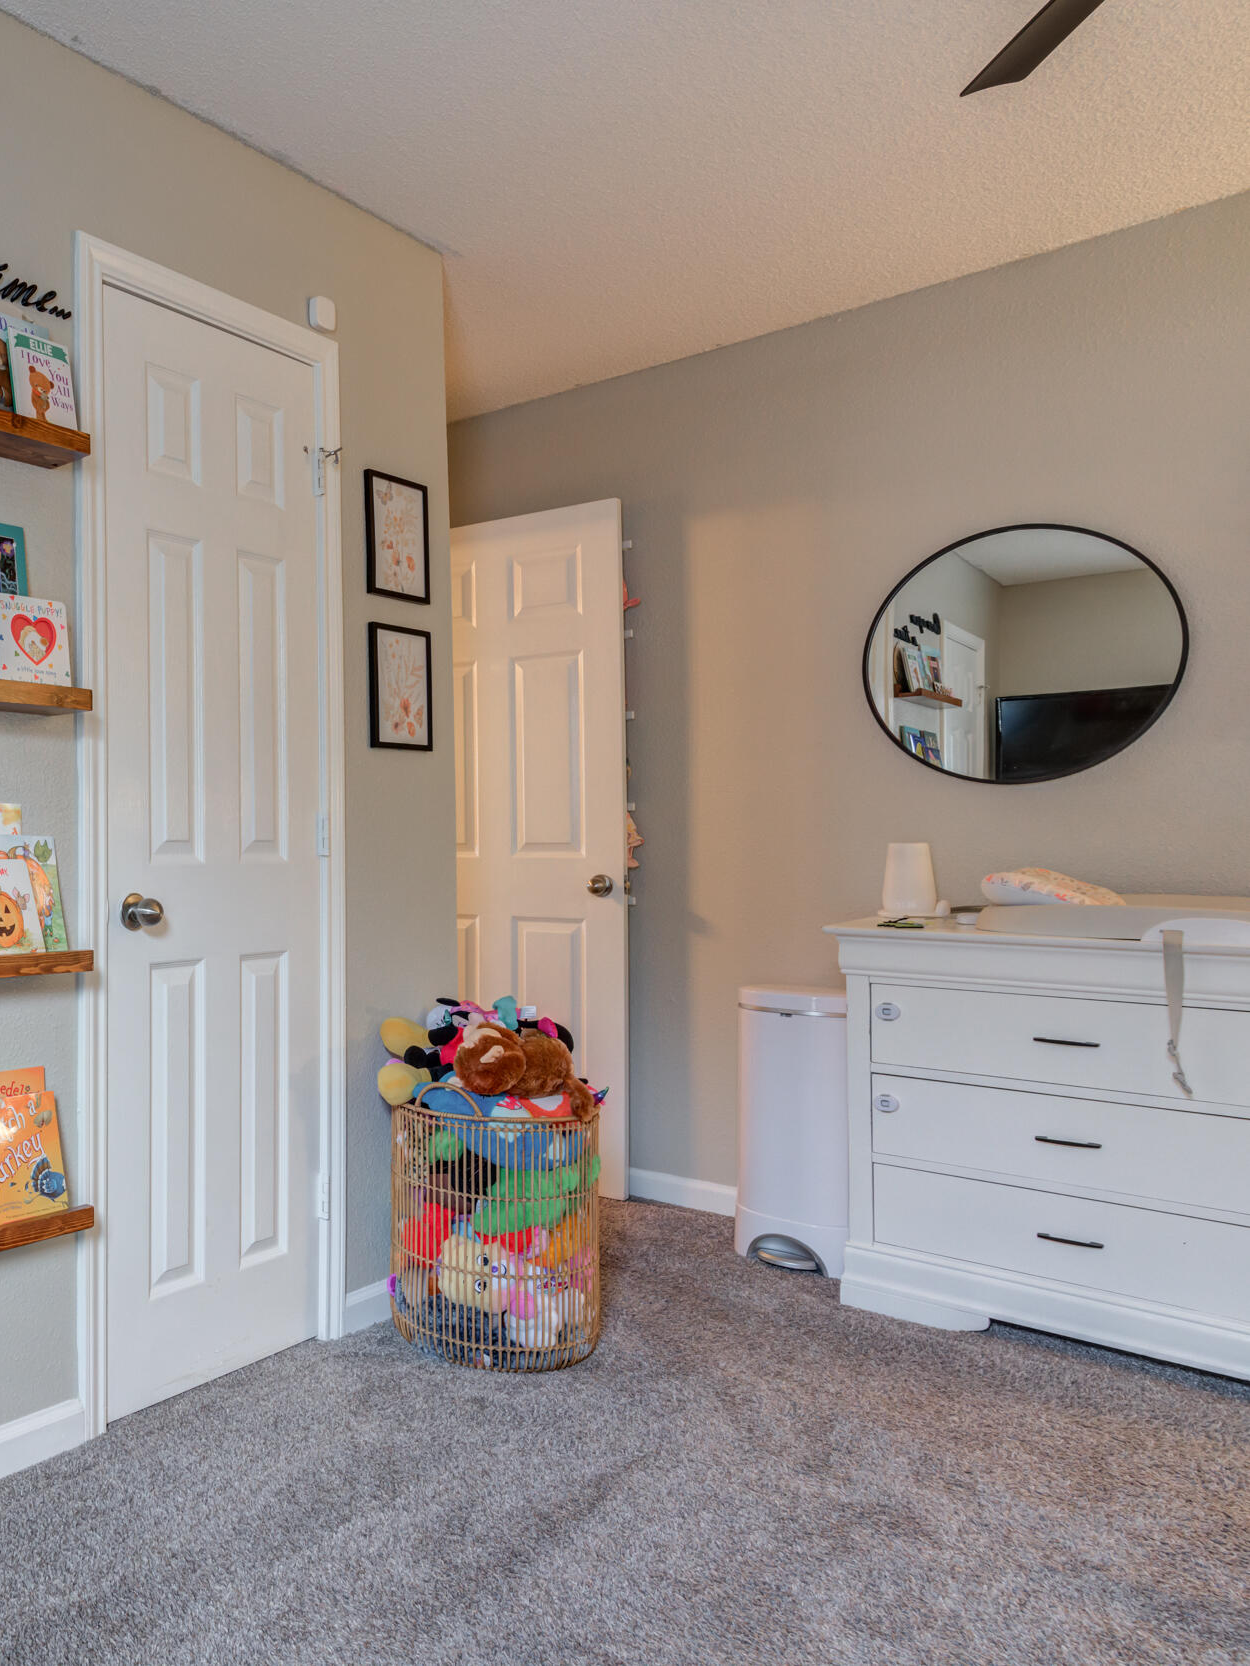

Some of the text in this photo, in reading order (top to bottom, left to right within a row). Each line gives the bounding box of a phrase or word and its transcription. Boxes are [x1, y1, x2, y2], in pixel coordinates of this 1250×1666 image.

[29, 338, 54, 357] ELLIE
[48, 368, 70, 386] You
[53, 384, 71, 398] All
[51, 395, 74, 413] Ways
[0, 599, 63, 618] SNUGGLE PUPPY!
[27, 1099, 38, 1116] a
